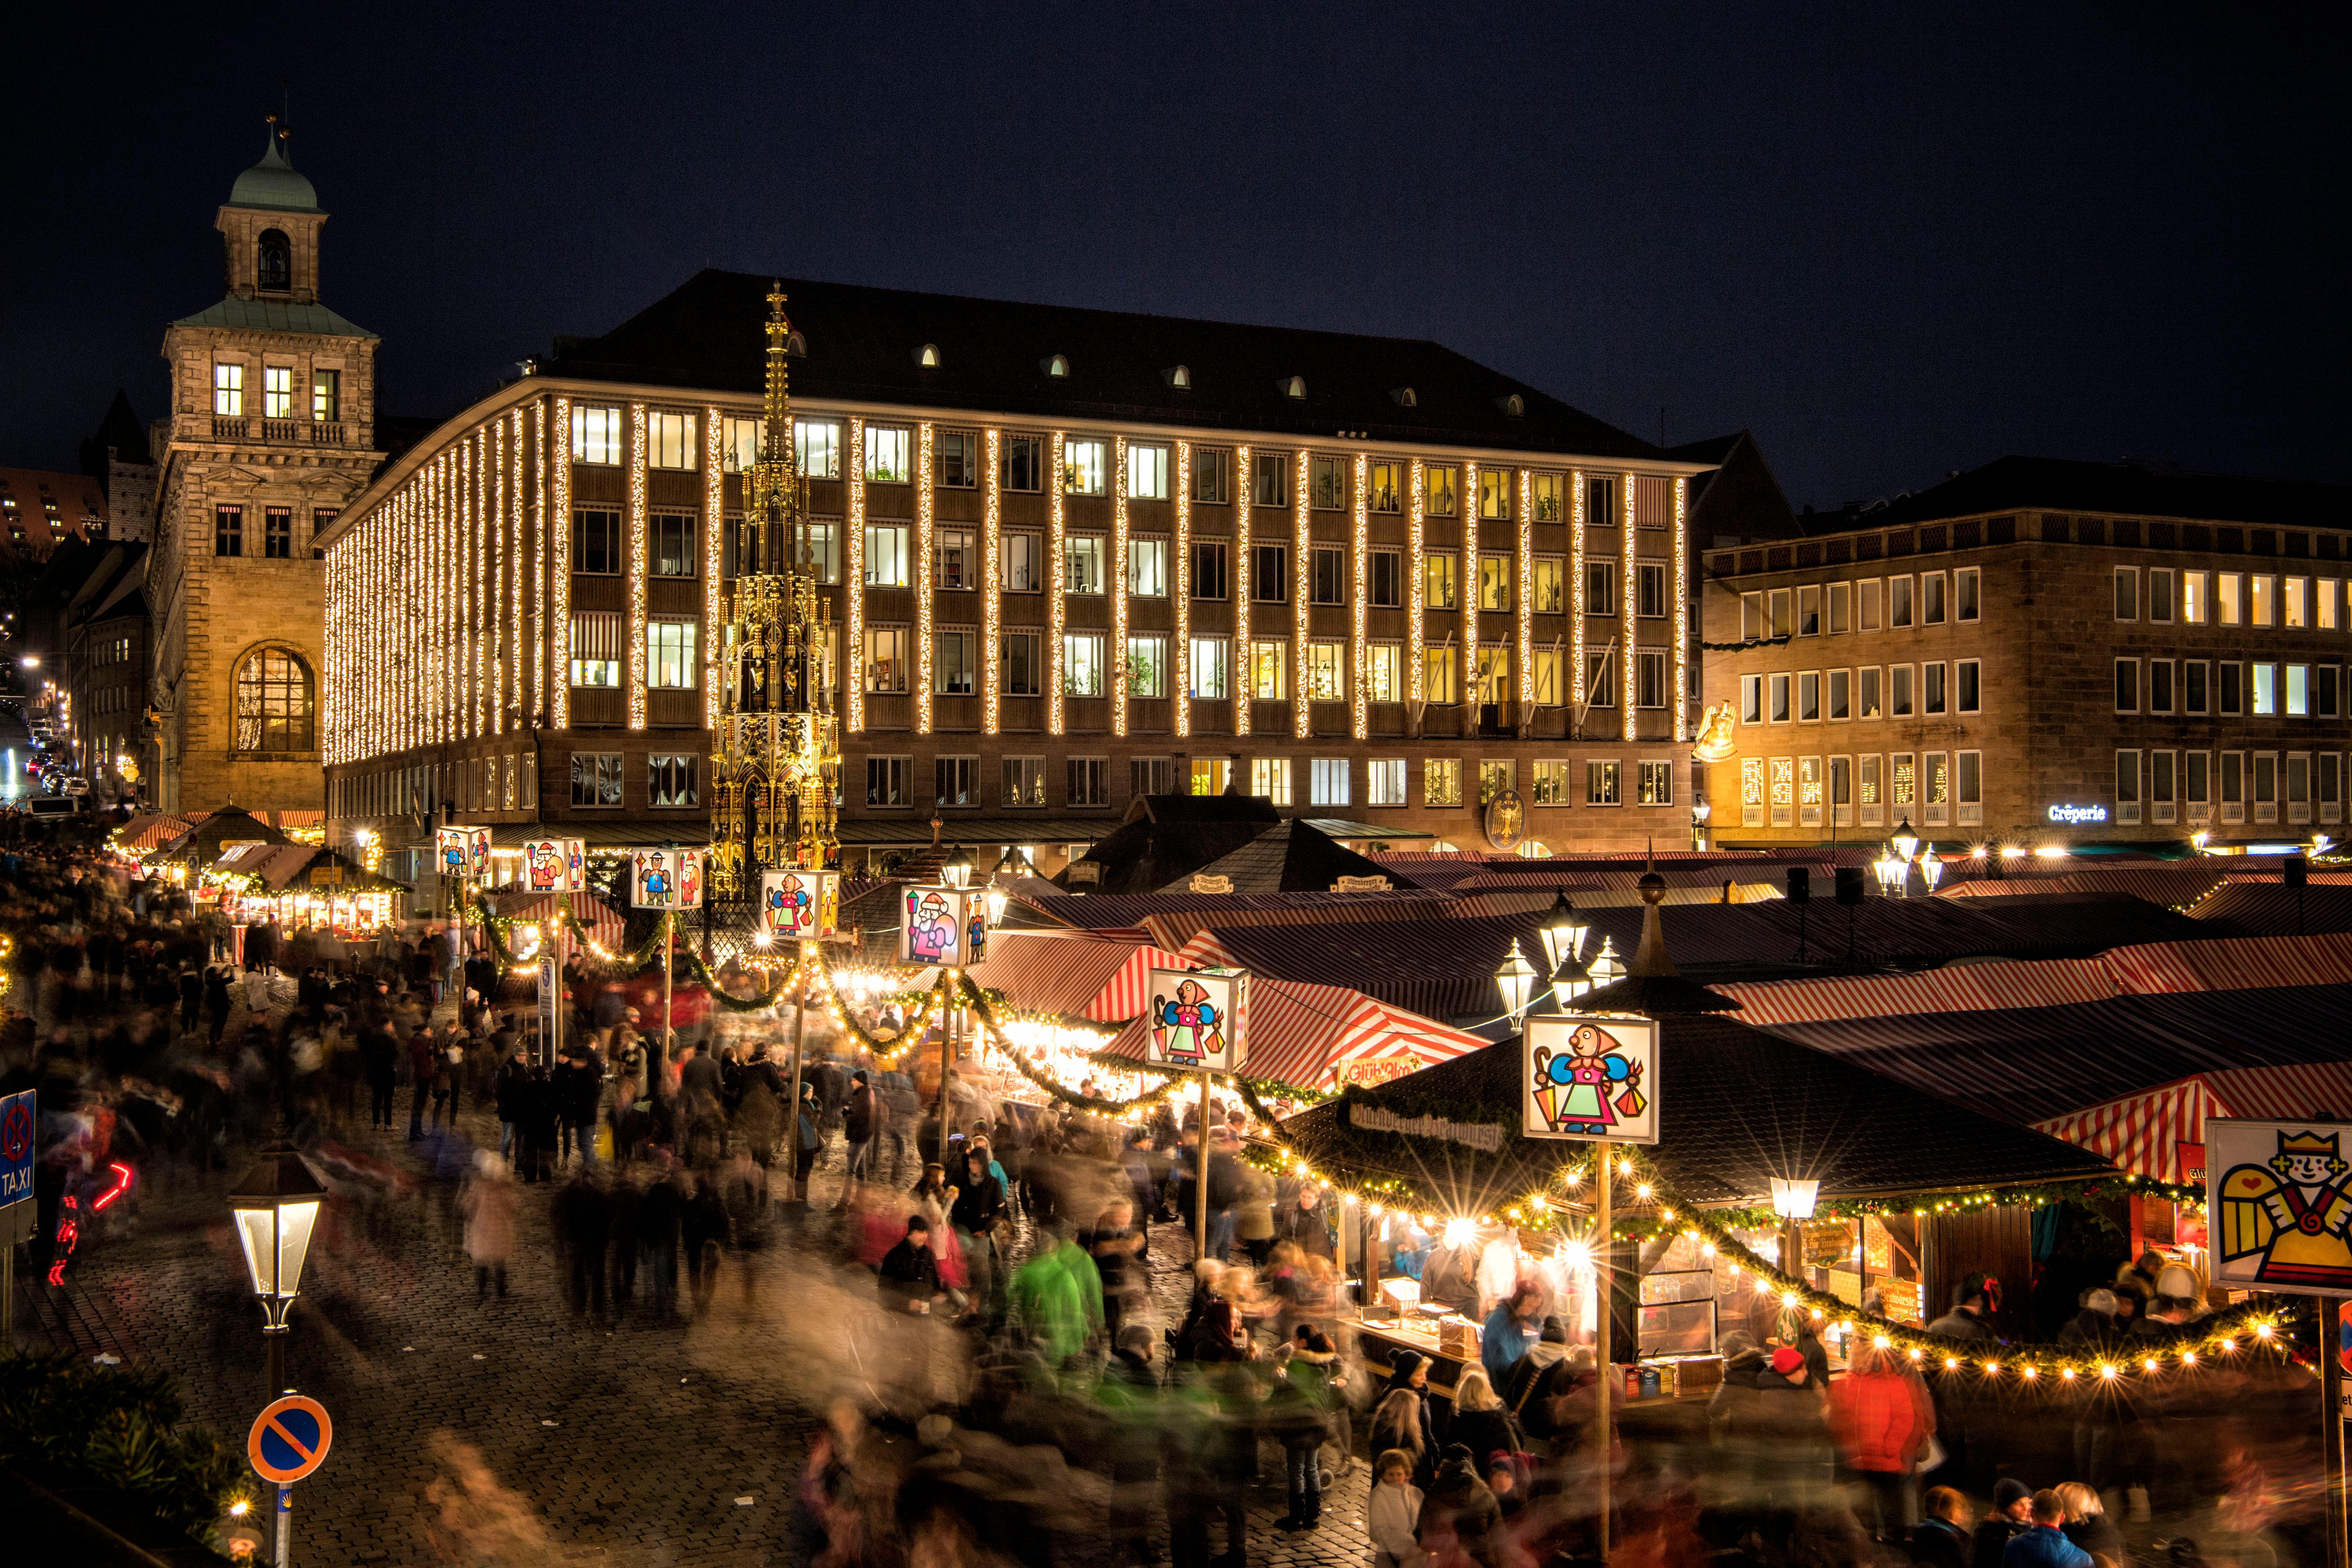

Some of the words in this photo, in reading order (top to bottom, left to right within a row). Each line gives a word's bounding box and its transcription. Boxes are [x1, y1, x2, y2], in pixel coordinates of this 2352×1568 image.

[2049, 805, 2106, 823] Crêperie
[1200, 876, 1222, 886] Nürnberger
[1347, 878, 1377, 886] Nürnberger
[2, 1166, 30, 1196] TAXI
[1880, 1289, 1915, 1307] Bratwürste
